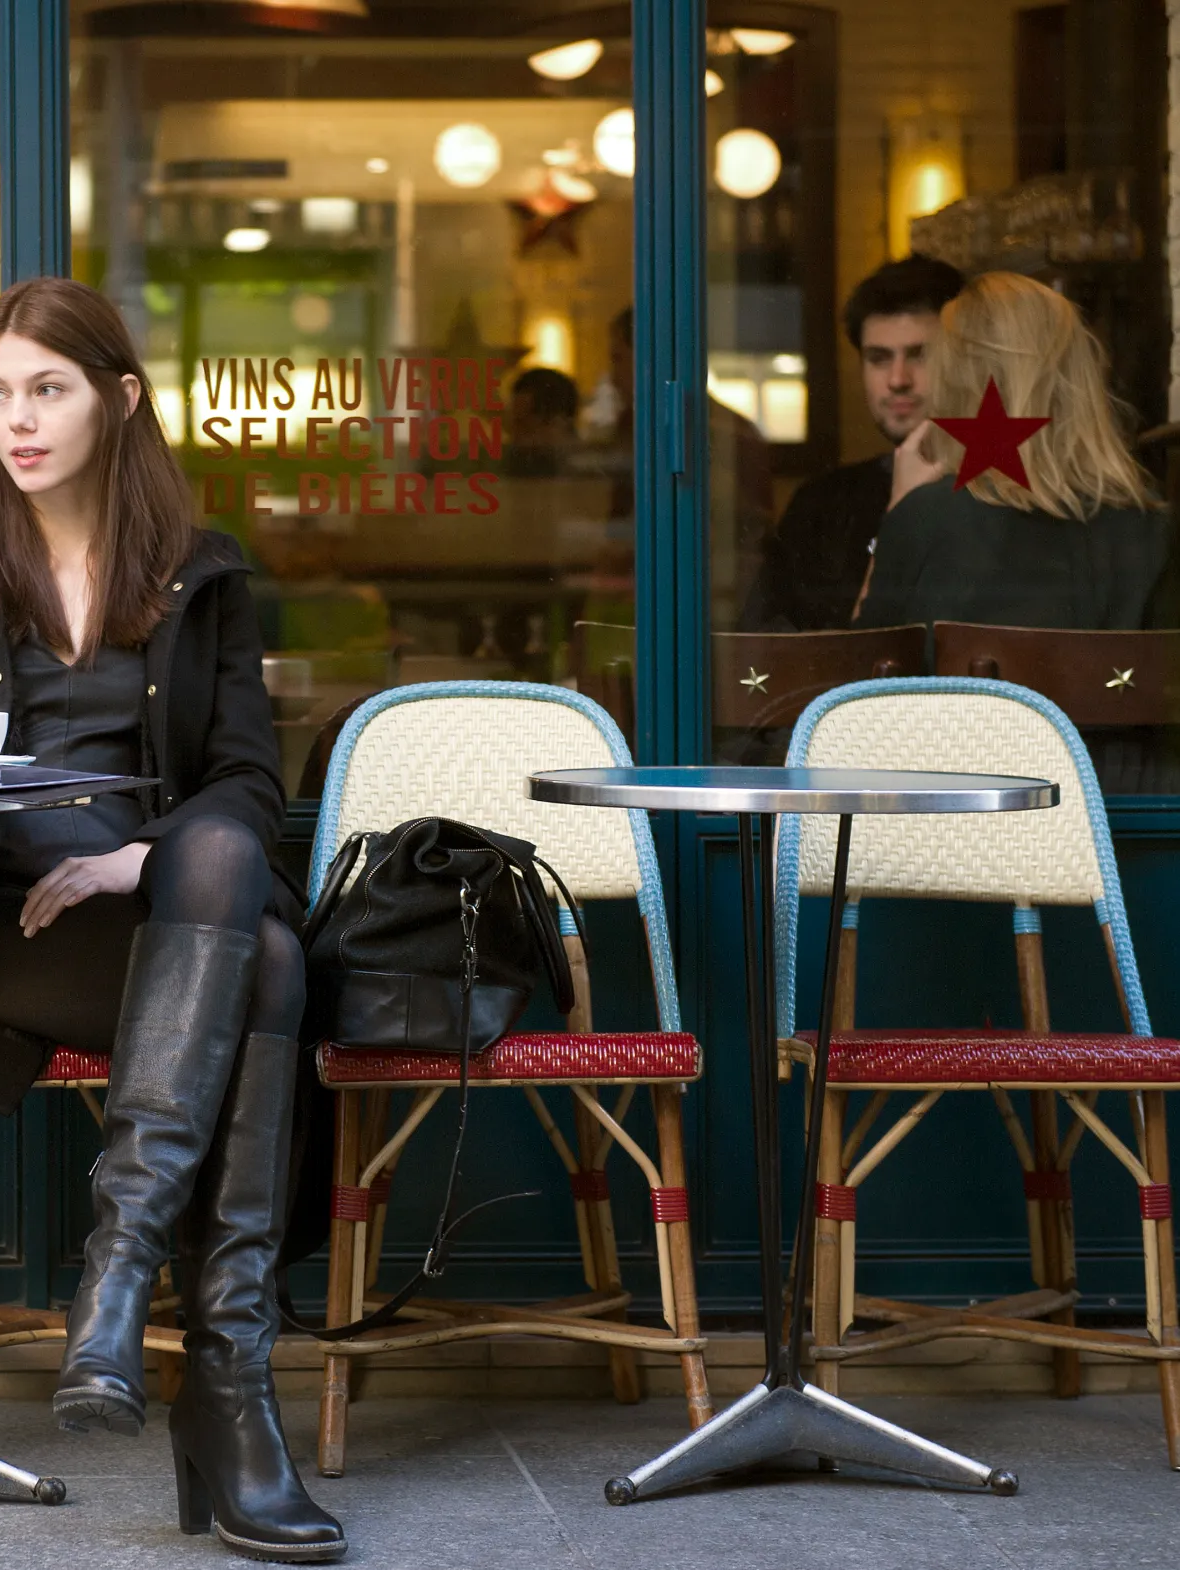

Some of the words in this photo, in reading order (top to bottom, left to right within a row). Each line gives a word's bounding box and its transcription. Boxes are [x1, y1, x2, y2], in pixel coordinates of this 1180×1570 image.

[202, 357, 295, 410] VINS
[311, 358, 362, 410] AU
[378, 358, 506, 411] VERRE
[202, 416, 503, 460] SELECTION
[204, 472, 273, 515] DE
[298, 464, 500, 515] BIÈRES
